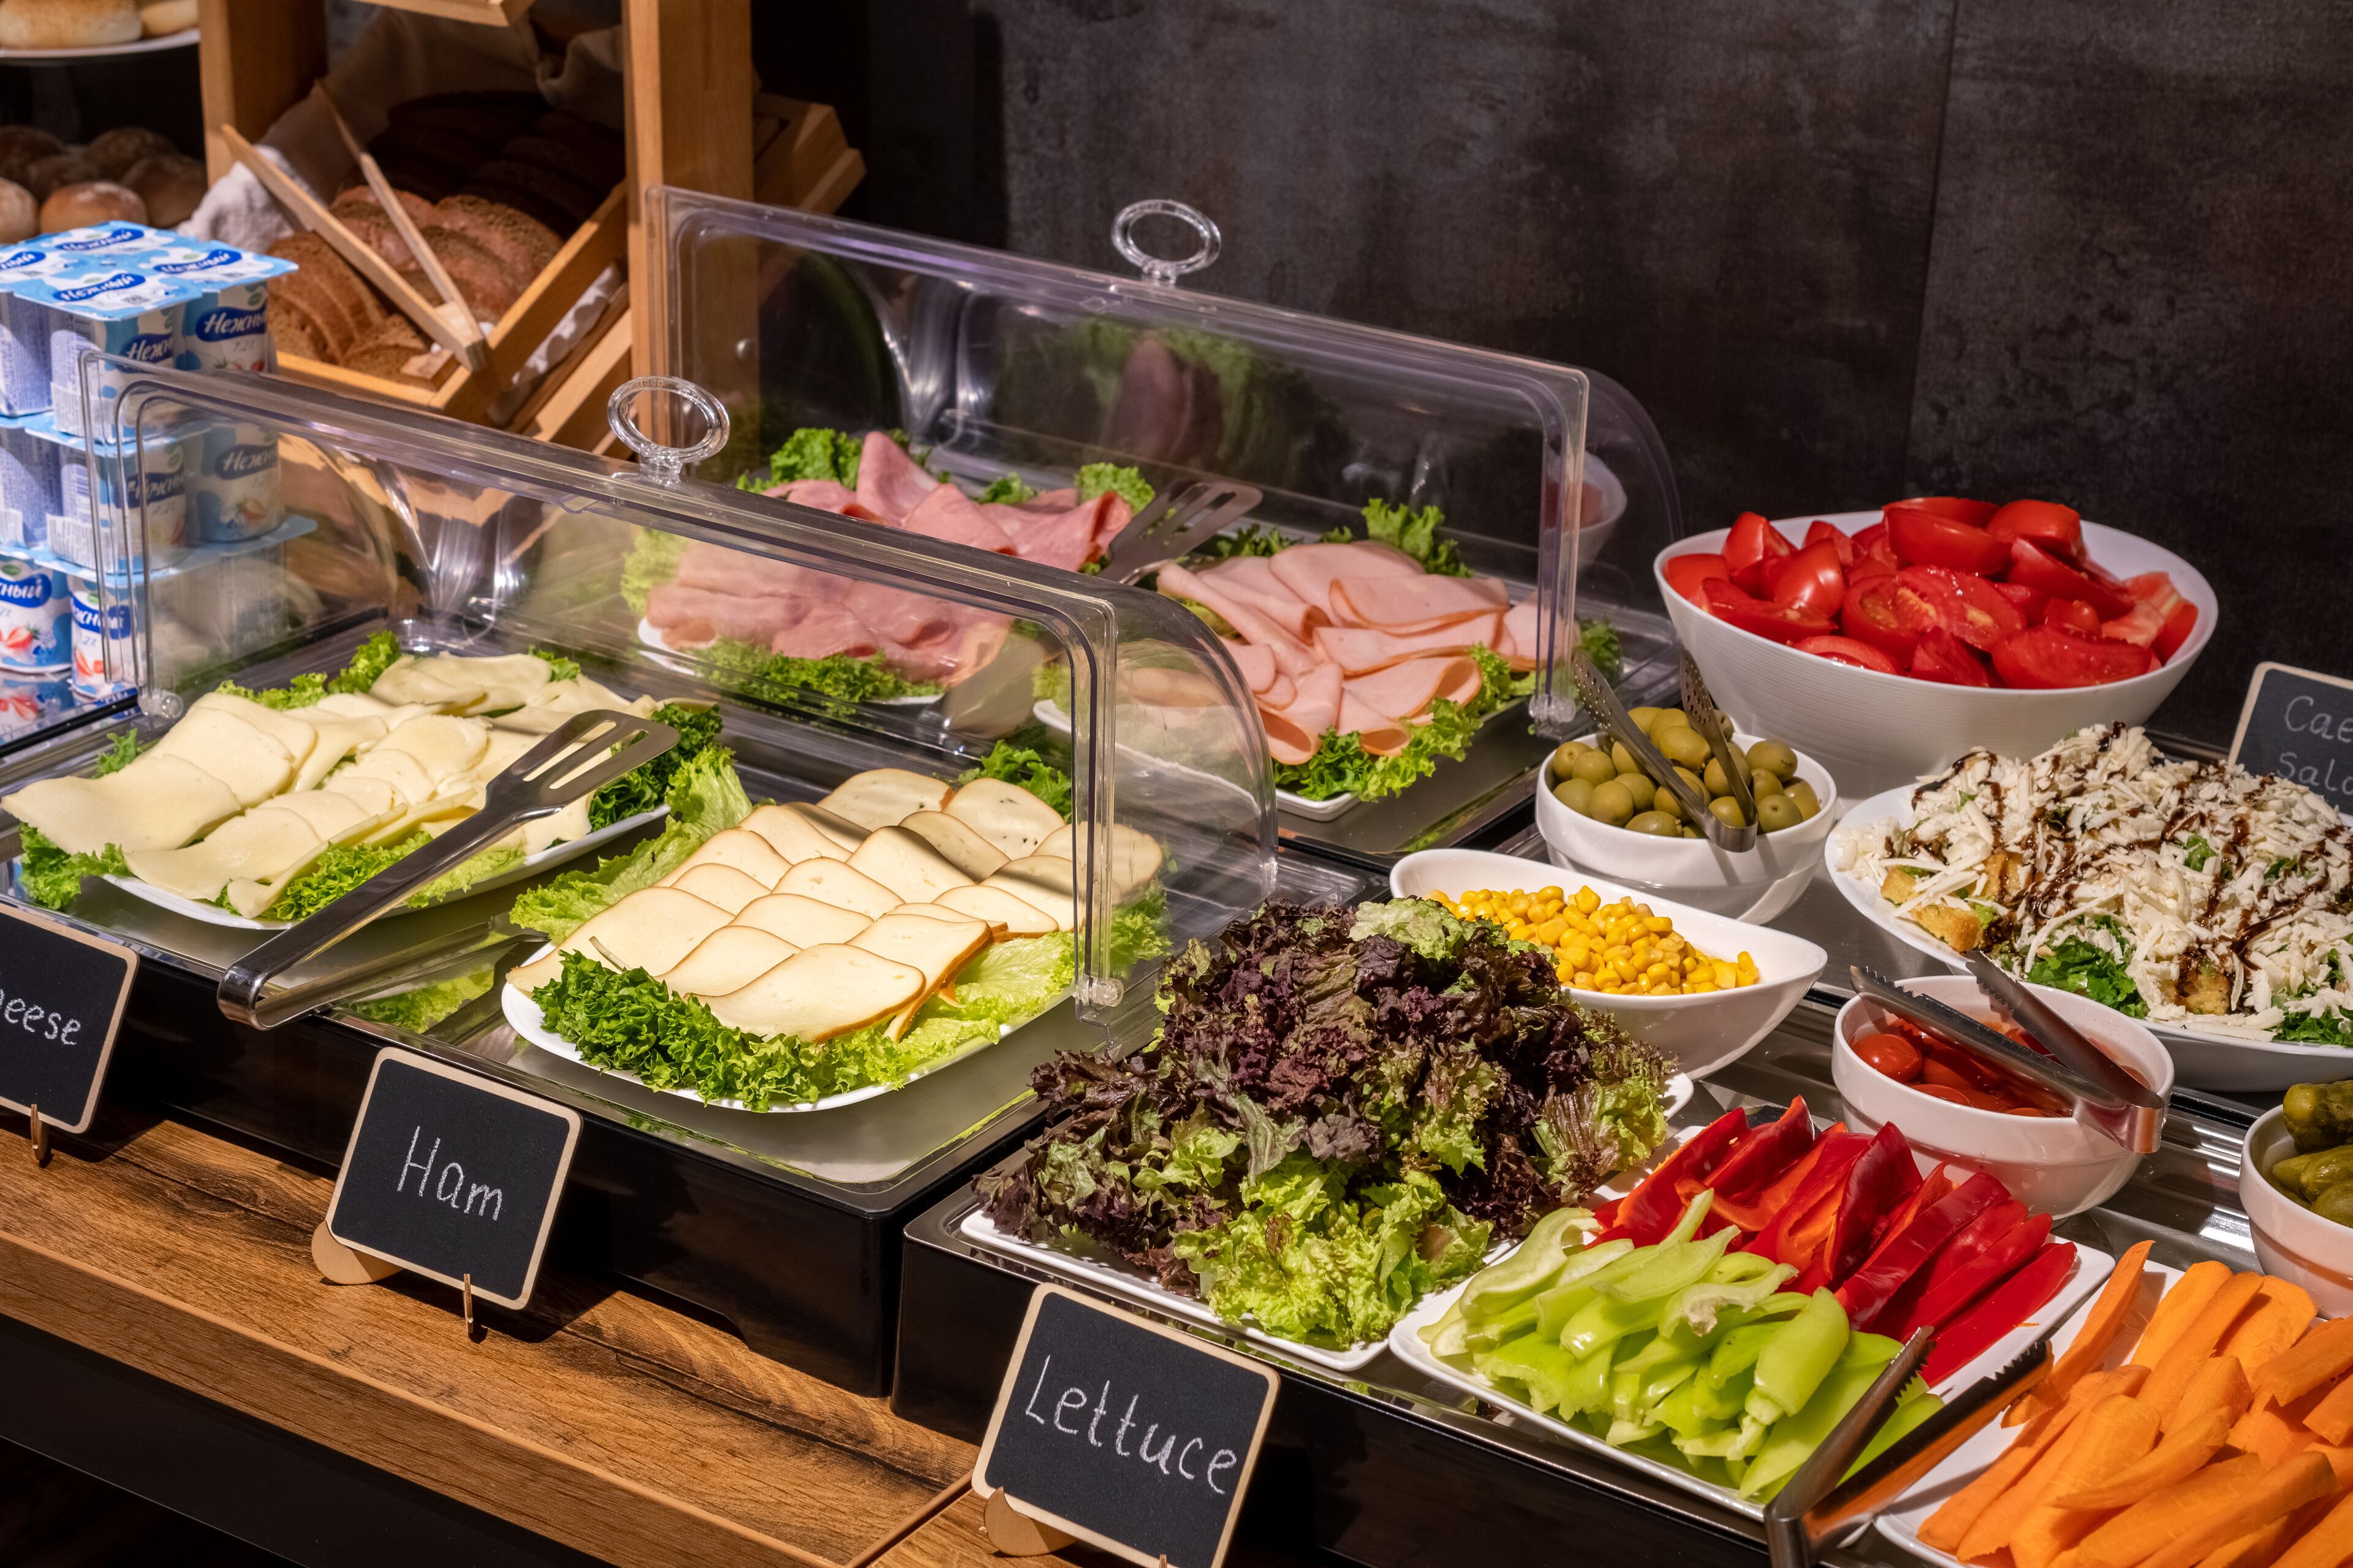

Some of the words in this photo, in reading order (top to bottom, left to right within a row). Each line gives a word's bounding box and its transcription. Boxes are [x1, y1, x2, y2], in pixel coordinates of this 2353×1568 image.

[0, 988, 81, 1045] eese
[396, 1125, 503, 1221] Ham
[1025, 1354, 1237, 1494] Lettuce
